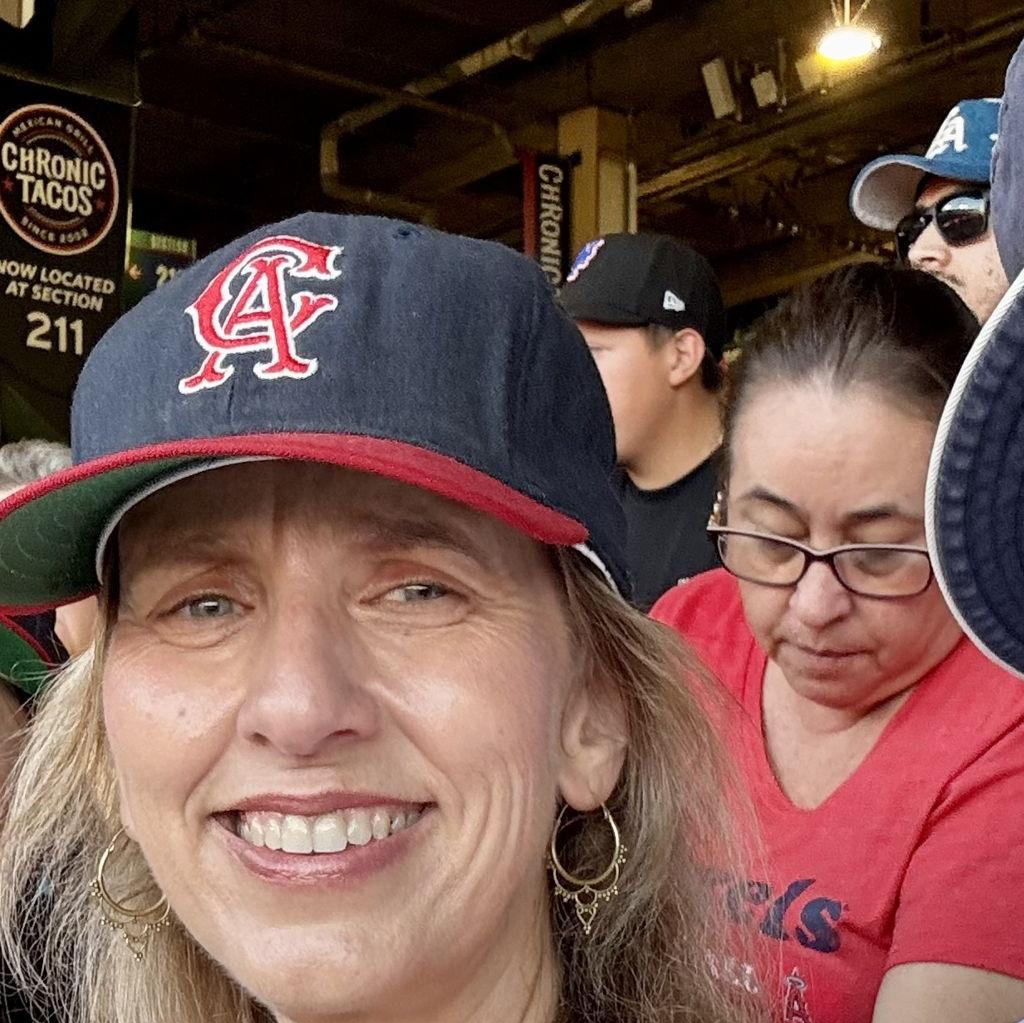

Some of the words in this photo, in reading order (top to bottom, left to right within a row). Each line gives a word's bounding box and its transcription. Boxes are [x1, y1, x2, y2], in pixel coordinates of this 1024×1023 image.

[1, 141, 106, 190] CHRONIC
[16, 173, 94, 216] TACOS
[5, 280, 29, 298] AT
[32, 284, 104, 312] SECTION
[40, 267, 116, 295] LOCATED
[26, 311, 84, 356] 211
